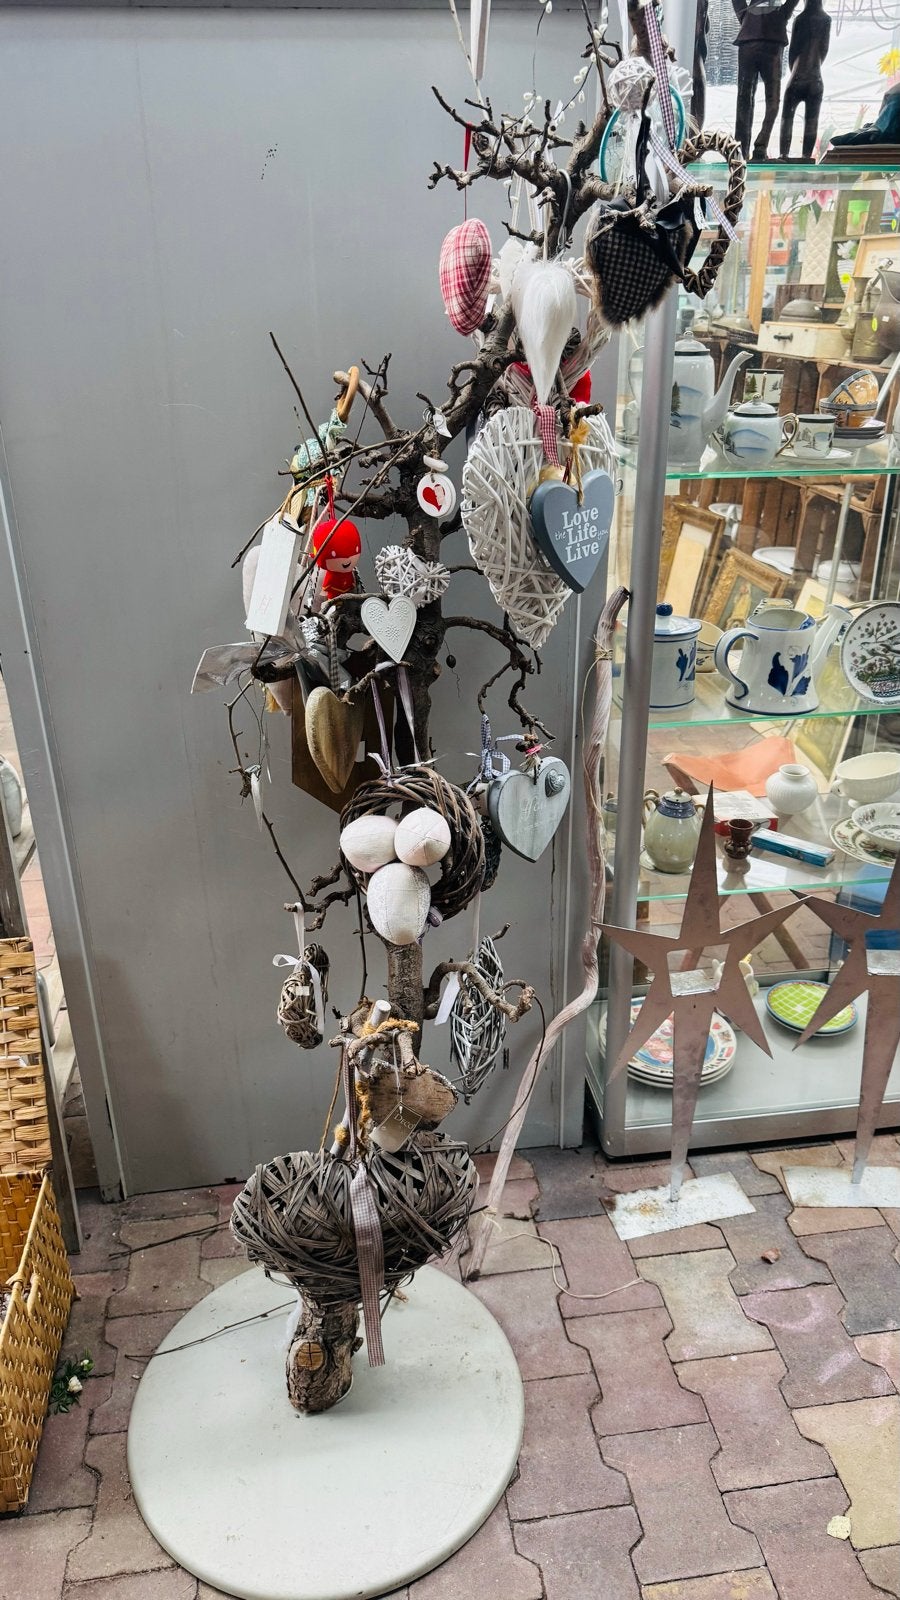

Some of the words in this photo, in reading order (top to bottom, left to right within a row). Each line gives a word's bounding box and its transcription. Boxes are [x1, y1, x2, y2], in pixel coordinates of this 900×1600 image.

[562, 507, 598, 529] Love
[555, 530, 566, 540] the
[566, 522, 597, 545] Life
[565, 542, 599, 563] Live
